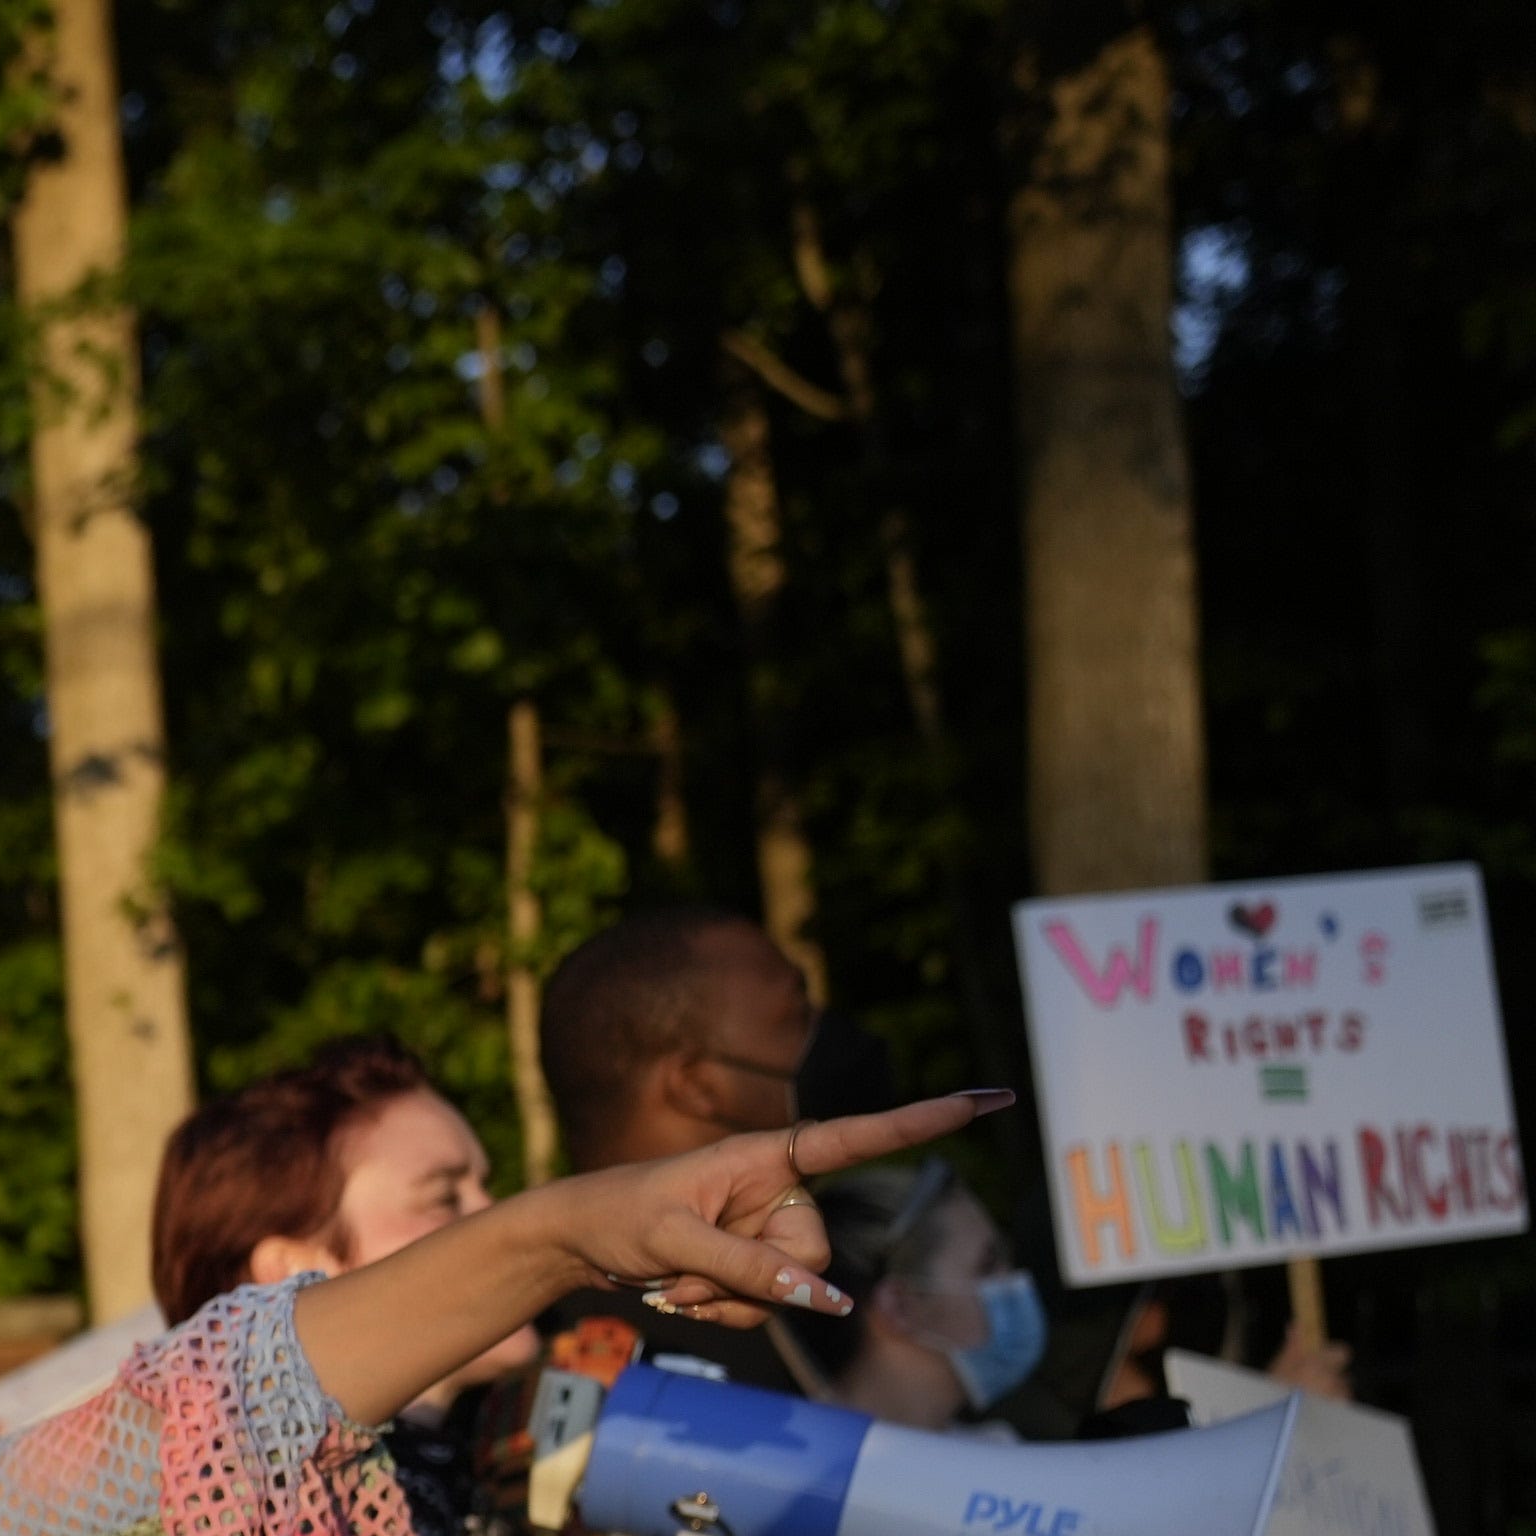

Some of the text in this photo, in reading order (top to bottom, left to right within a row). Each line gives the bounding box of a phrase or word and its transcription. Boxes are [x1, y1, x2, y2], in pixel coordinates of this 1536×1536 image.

[1183, 1012, 1365, 1061] RIGHTS
[1066, 1125, 1526, 1268] HUMAN RIGHTS
